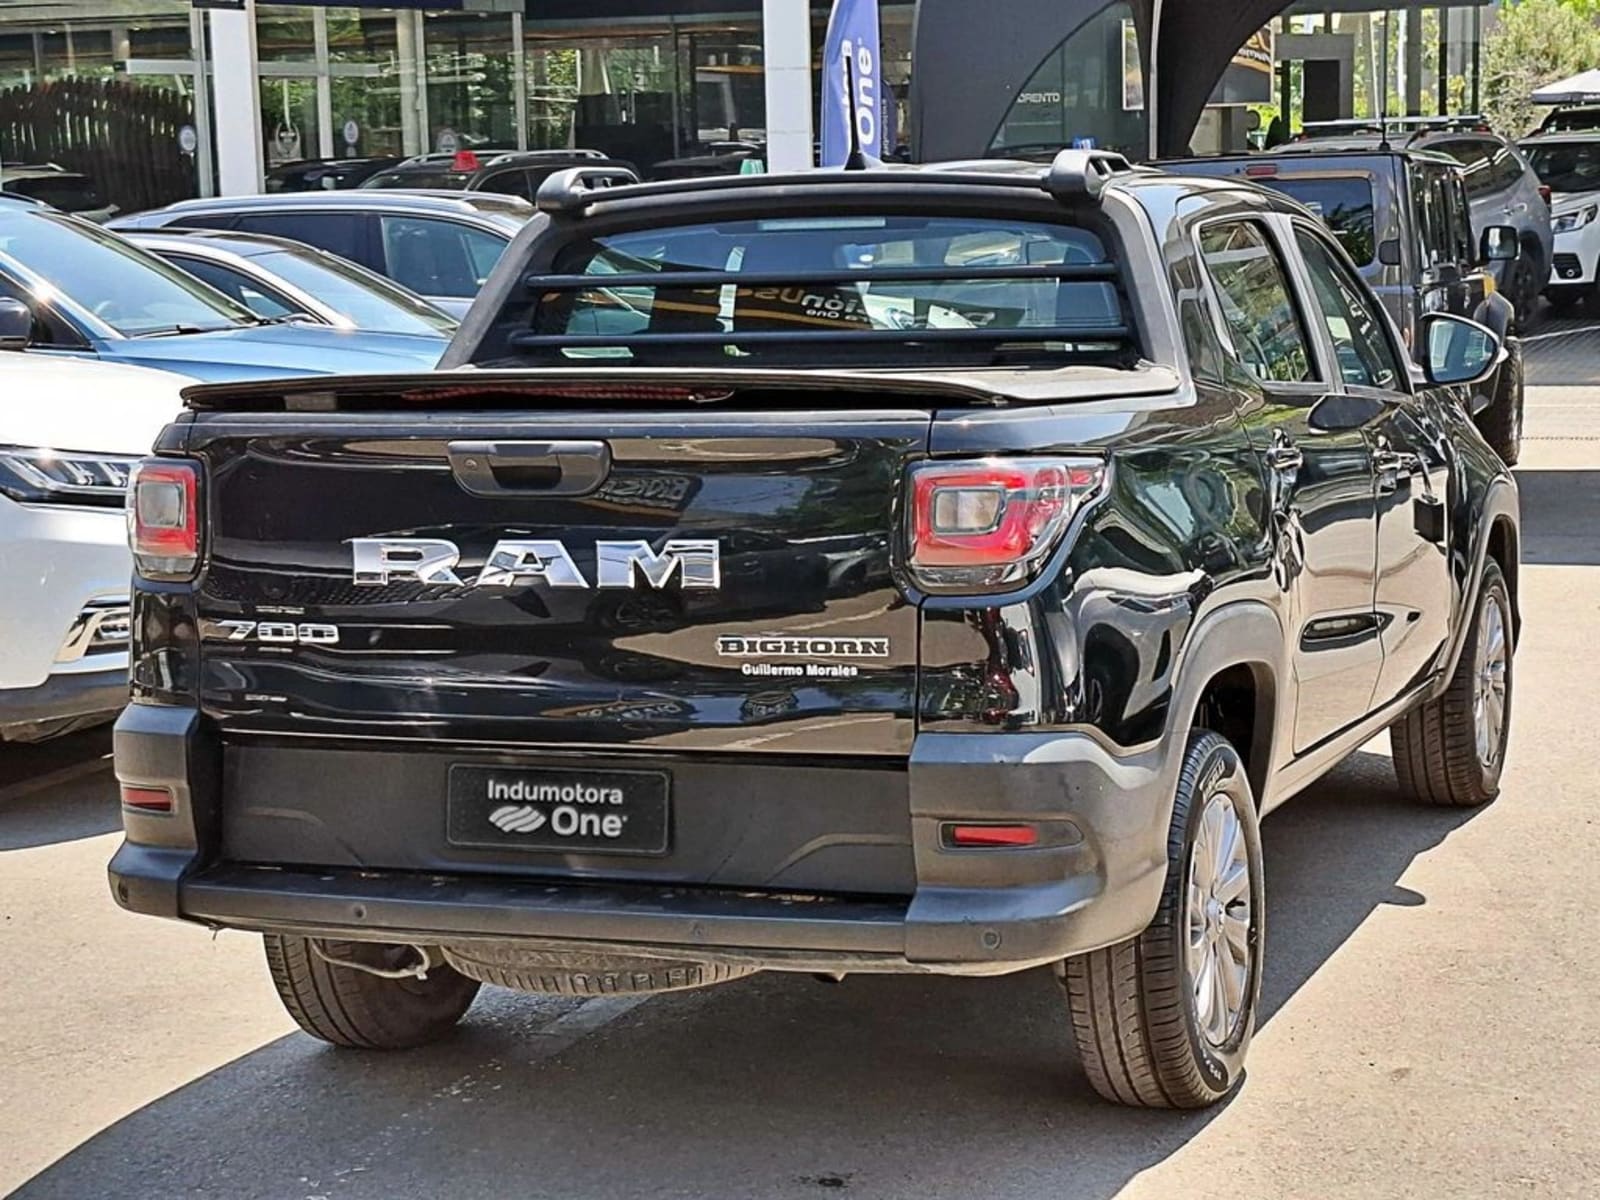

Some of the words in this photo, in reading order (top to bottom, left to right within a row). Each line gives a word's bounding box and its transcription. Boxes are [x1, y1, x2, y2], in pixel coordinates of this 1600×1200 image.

[857, 47, 875, 145] One
[1017, 92, 1061, 103] ORENTO
[349, 537, 721, 589] RAM
[216, 619, 340, 644] 700
[716, 636, 889, 657] BIGHORN
[741, 663, 803, 676] Guillermo
[806, 663, 858, 677] Morales
[487, 779, 624, 804] Indumotora
[551, 806, 624, 837] One
